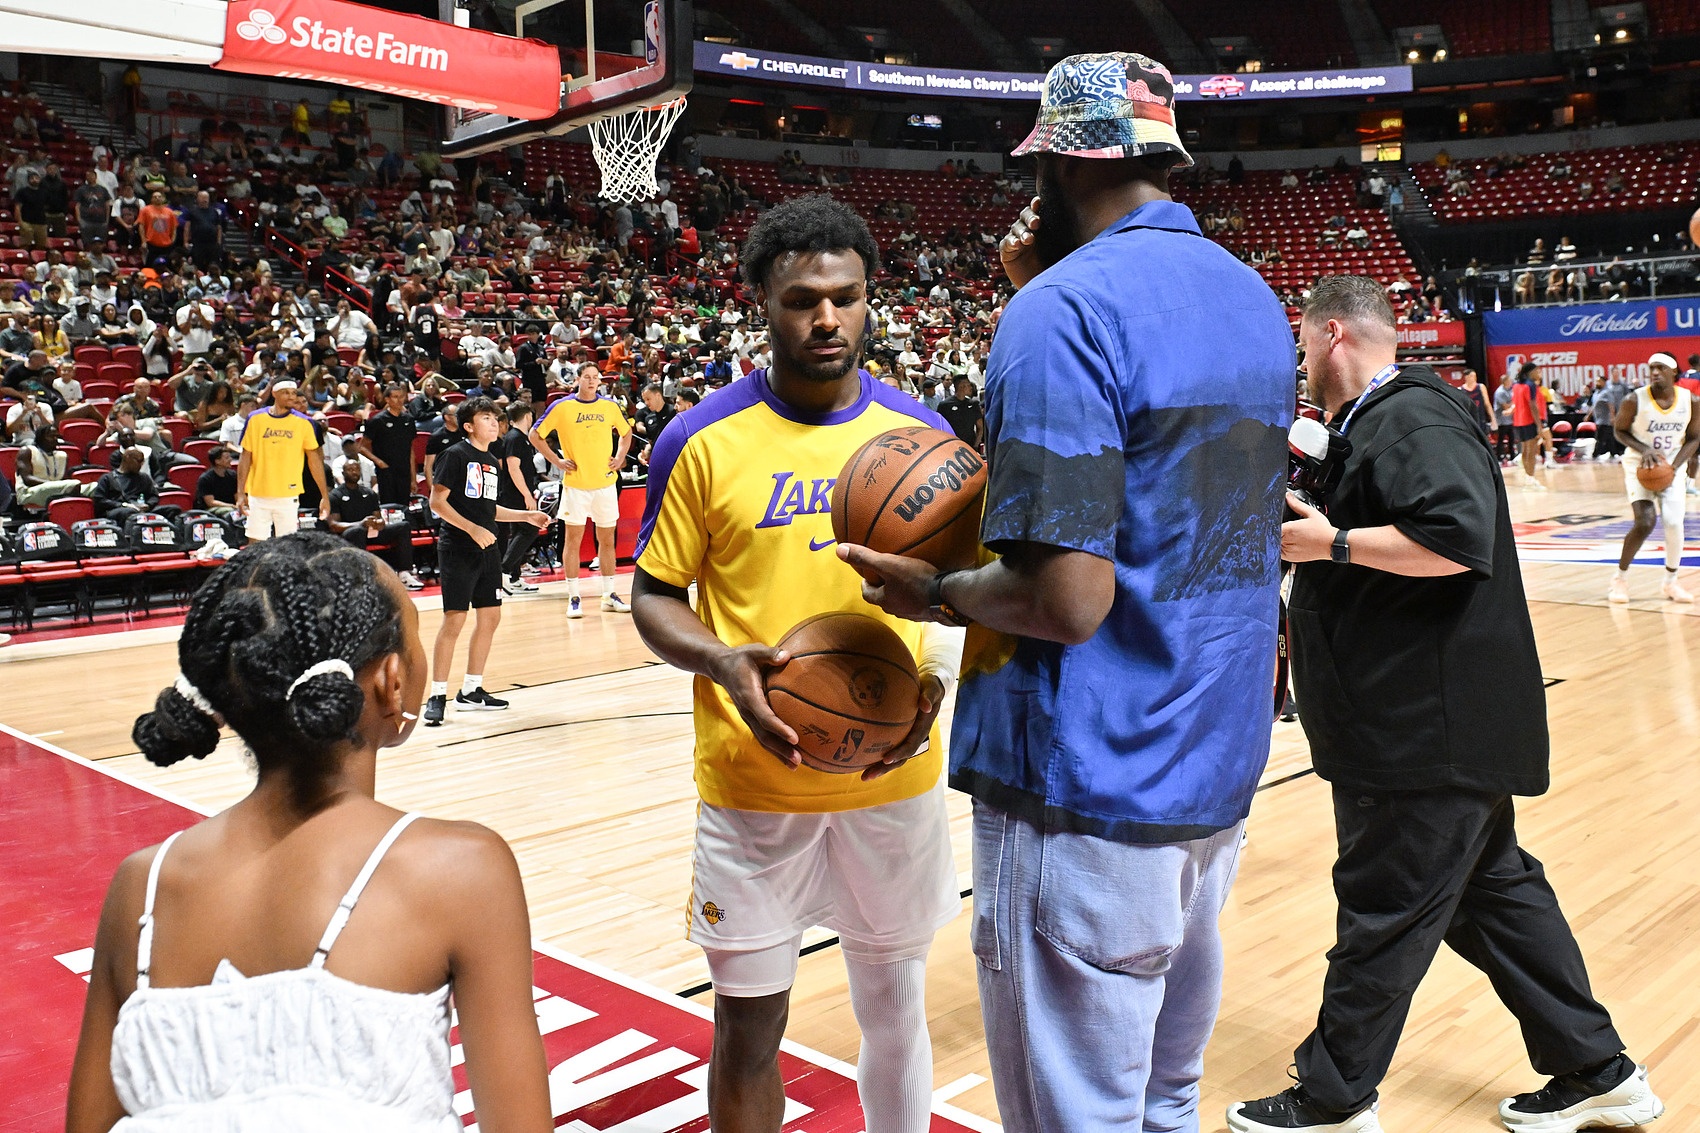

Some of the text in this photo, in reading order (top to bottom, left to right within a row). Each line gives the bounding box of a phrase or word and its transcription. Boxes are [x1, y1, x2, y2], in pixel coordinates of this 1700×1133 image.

[762, 59, 848, 79] CHEVROLET
[869, 70, 925, 86] Southern
[927, 74, 971, 89] Nevada
[973, 77, 1010, 93] Chevy
[1011, 79, 1044, 92] Deale
[1250, 75, 1386, 93] Accept all challenges
[1559, 311, 1650, 336] Michelob
[1530, 351, 1579, 366] 2K26
[576, 412, 605, 423] LAKERS
[1646, 420, 1684, 433] LAKERS
[262, 427, 293, 438] LAKERS
[1653, 436, 1672, 449] 65
[892, 446, 984, 522] Wilson
[755, 471, 836, 529] LAK
[1278, 634, 1287, 658] EOS
